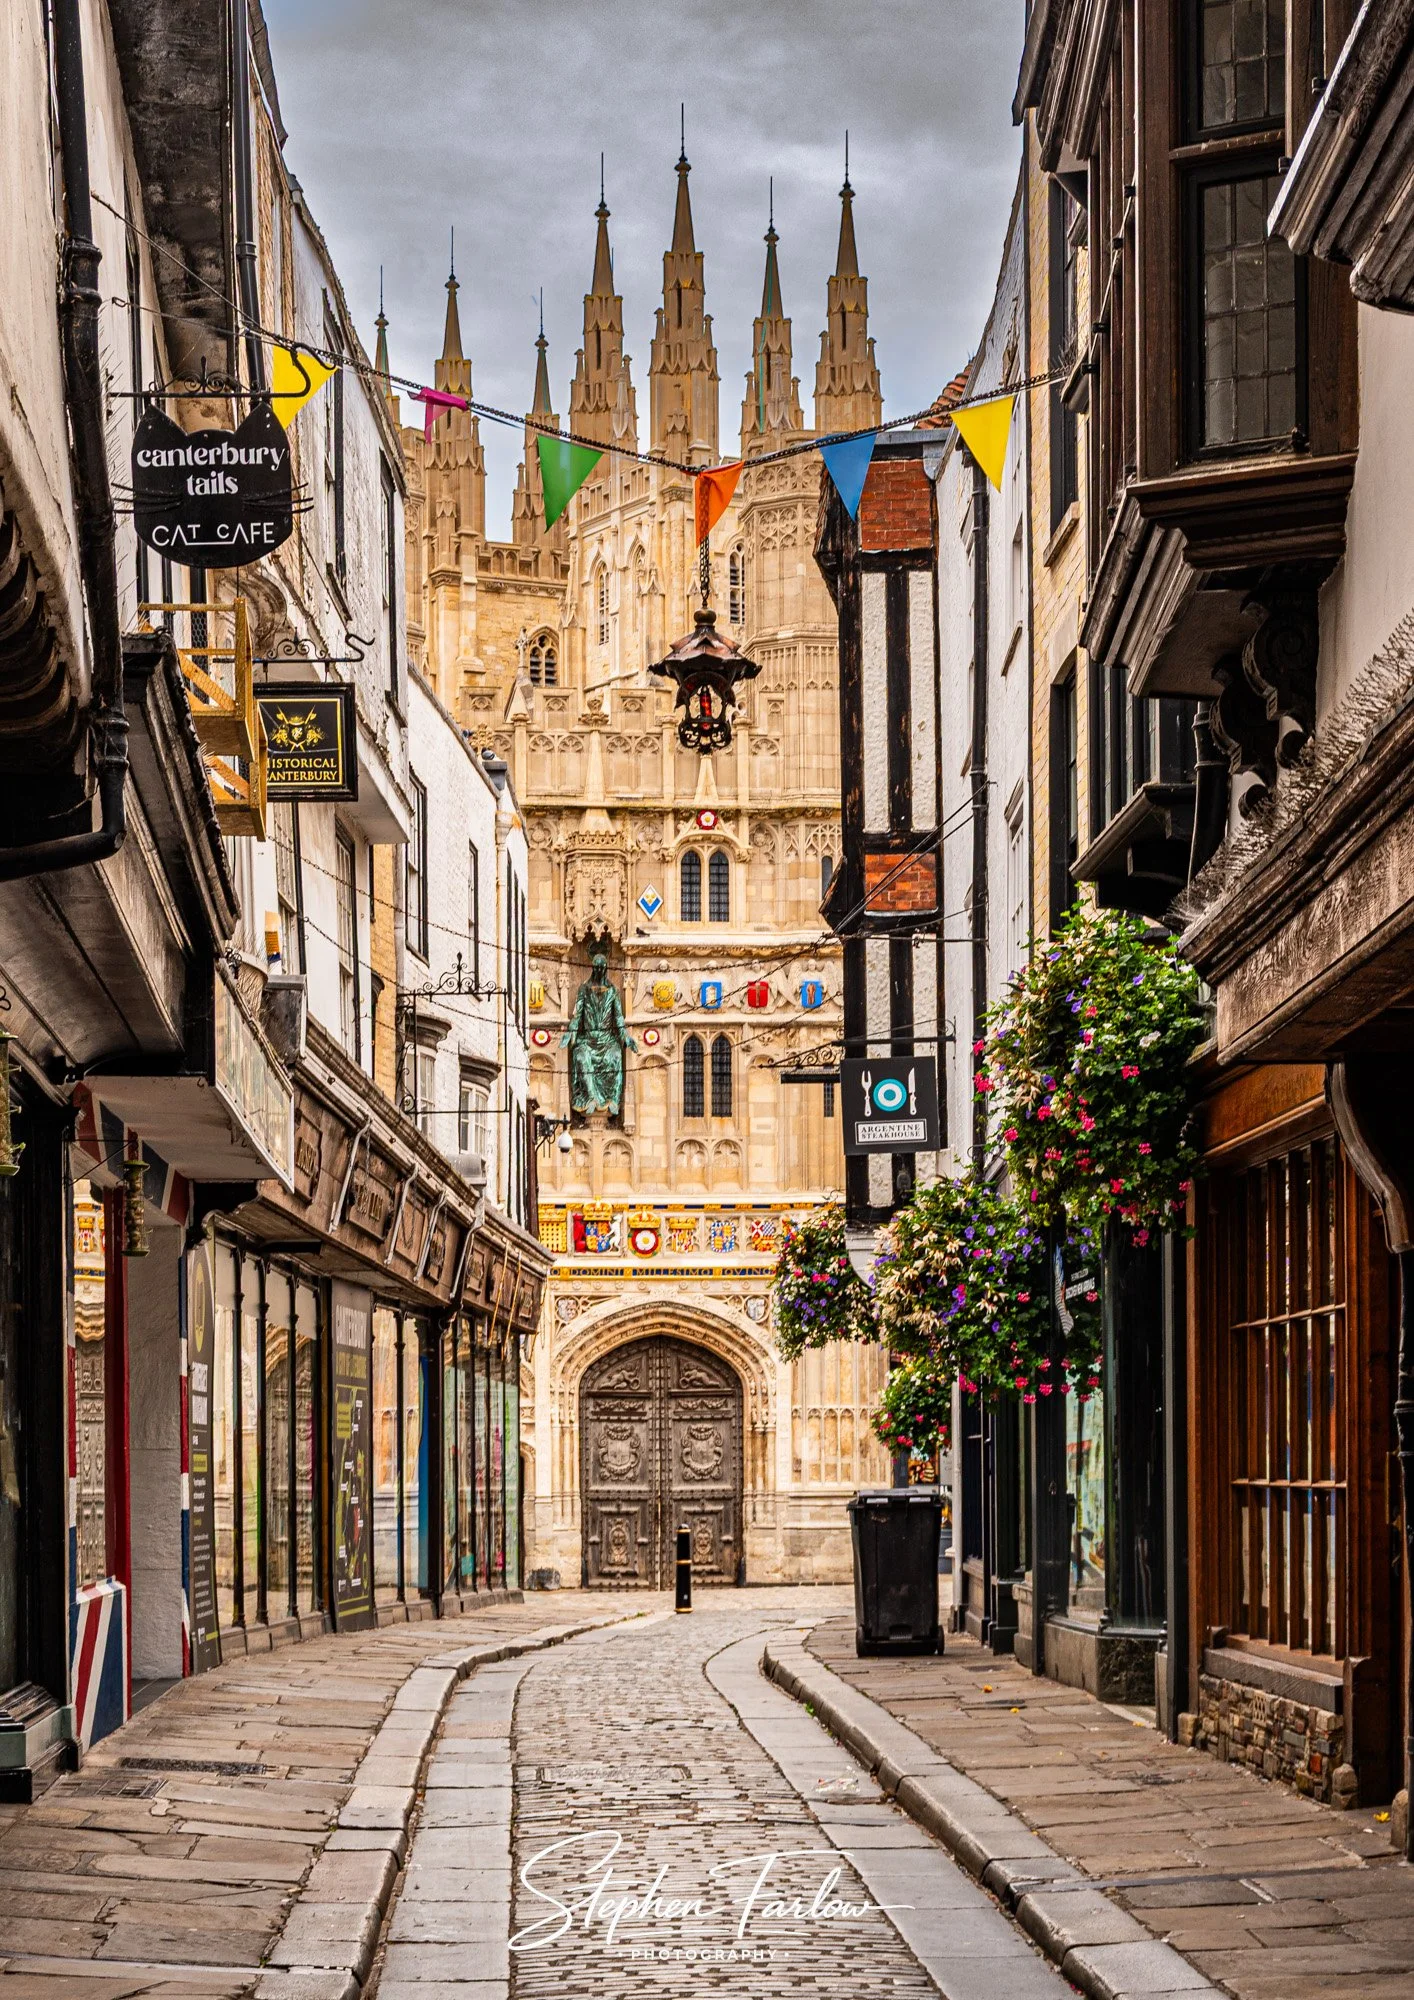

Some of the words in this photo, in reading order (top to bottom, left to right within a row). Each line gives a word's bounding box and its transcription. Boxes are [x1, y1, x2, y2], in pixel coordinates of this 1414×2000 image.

[136, 441, 286, 471] canterbury
[186, 470, 239, 496] tails
[151, 523, 201, 547] CAT
[216, 521, 276, 545] CAFE
[267, 770, 338, 781] ANTERBURY
[861, 1123, 921, 1134] ARGENTINE
[861, 1130, 921, 1140] STEAKHOUSE
[570, 1267, 624, 1276] DOMINI
[636, 1267, 712, 1276] MILLESIMO
[721, 1267, 773, 1276] QVING
